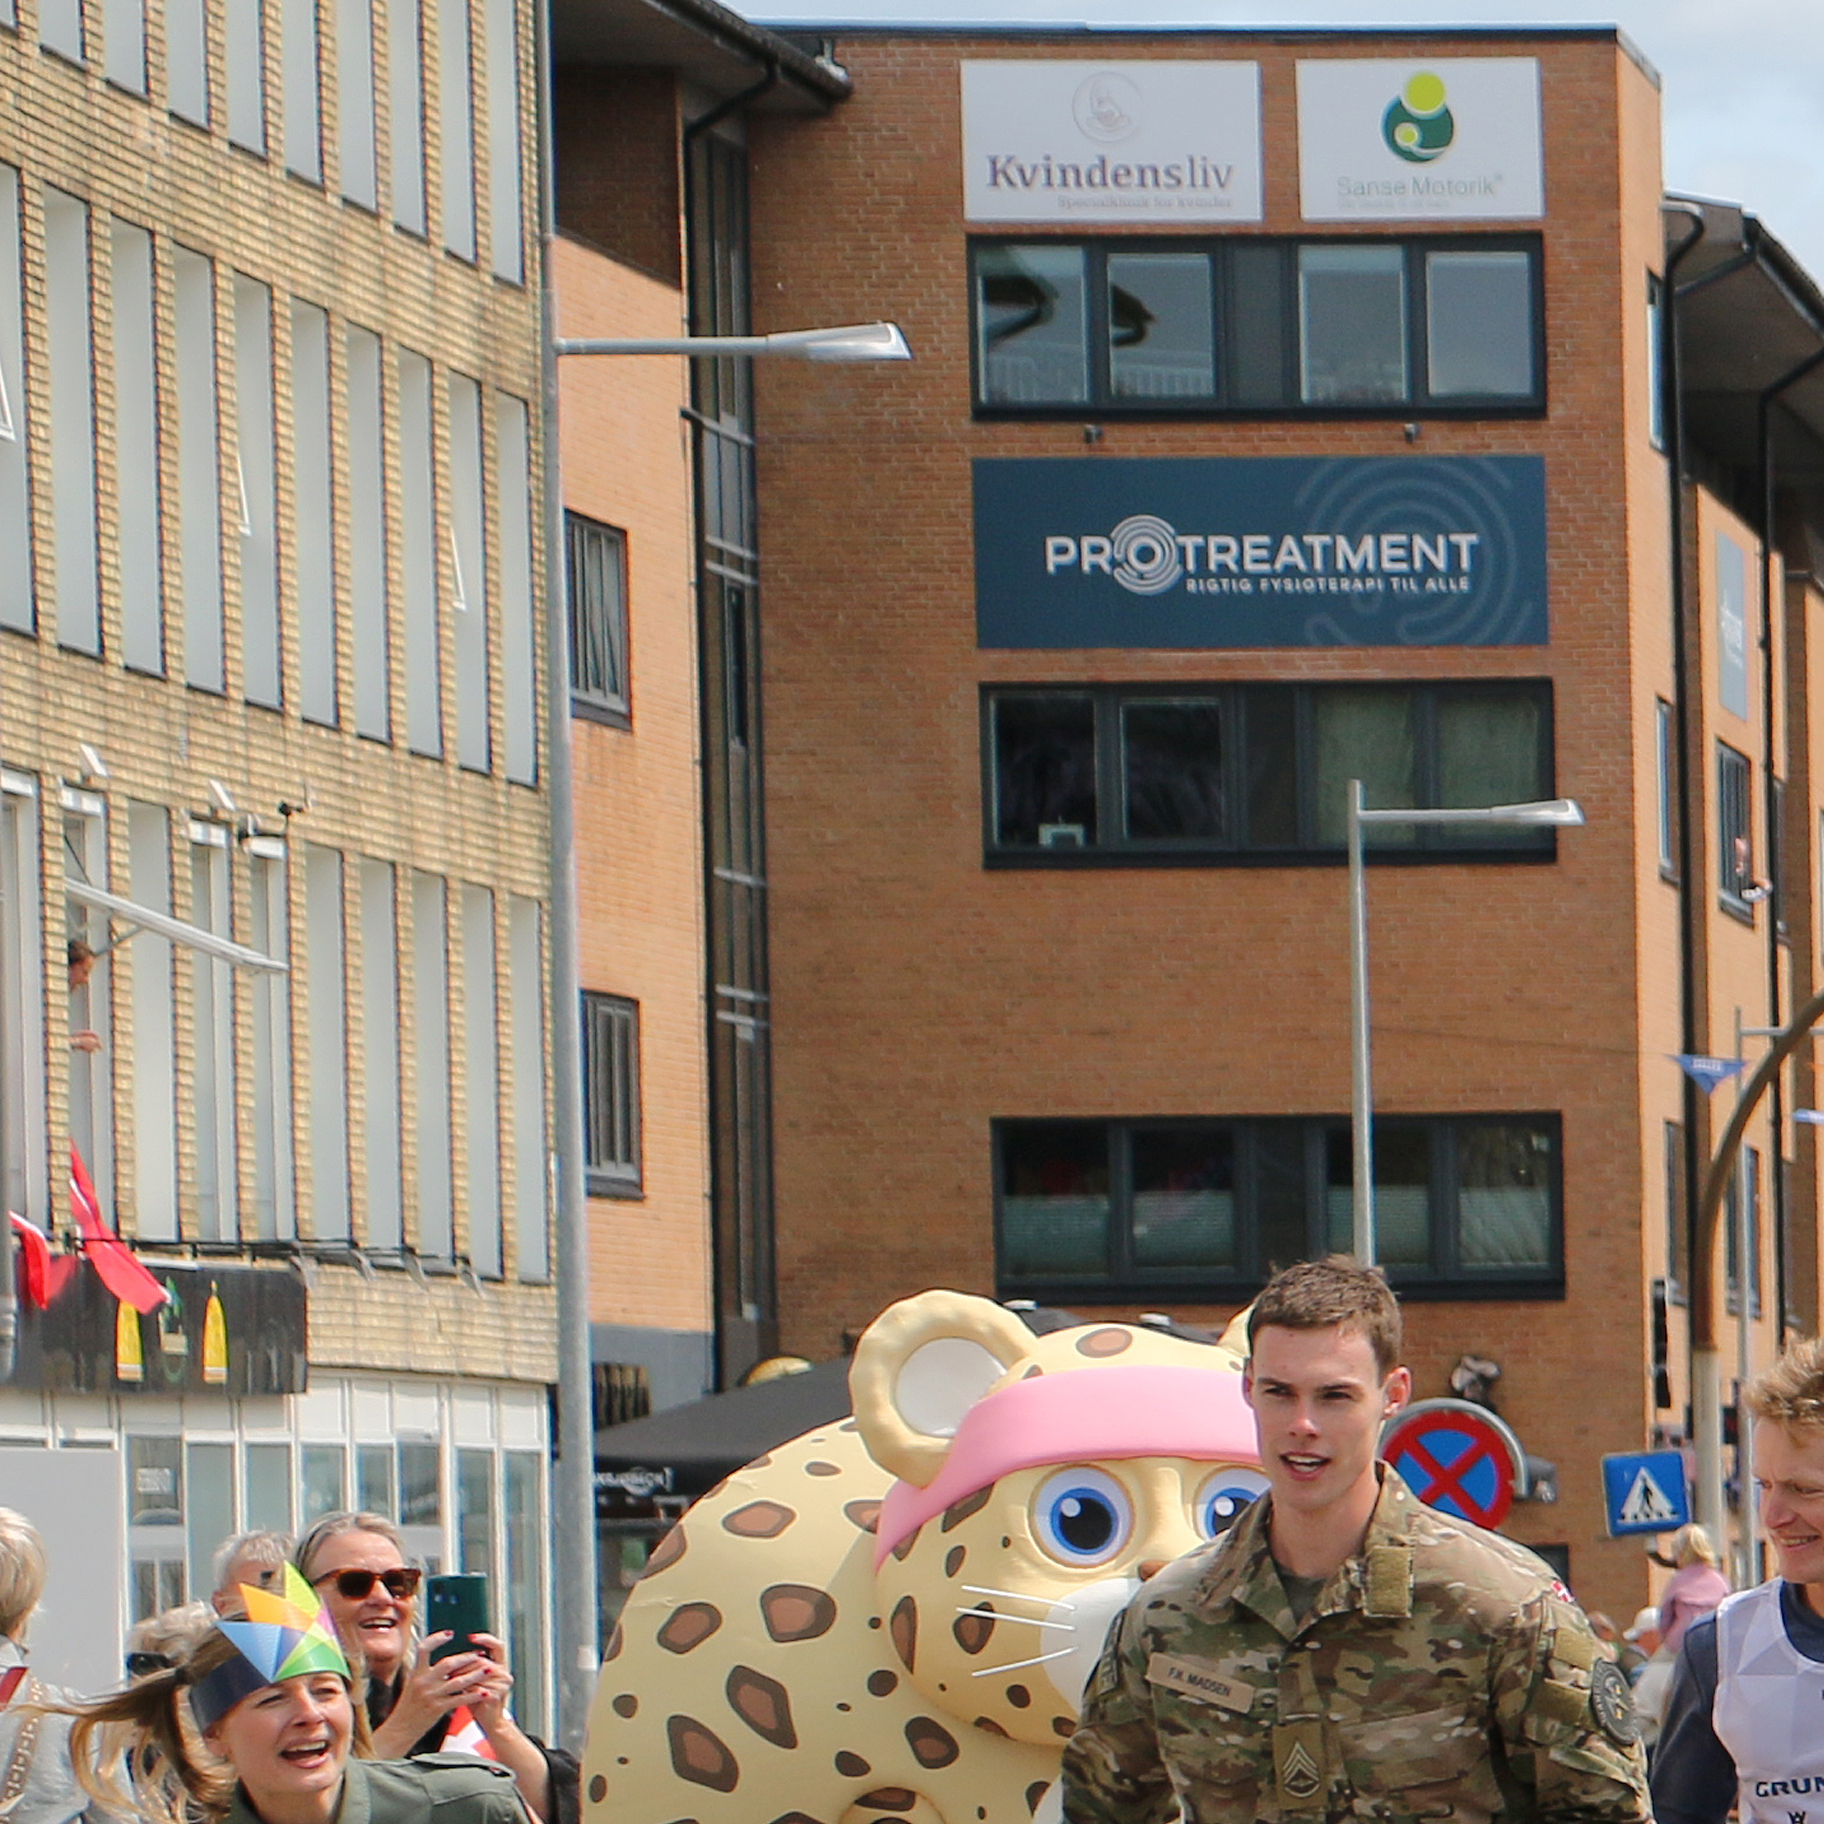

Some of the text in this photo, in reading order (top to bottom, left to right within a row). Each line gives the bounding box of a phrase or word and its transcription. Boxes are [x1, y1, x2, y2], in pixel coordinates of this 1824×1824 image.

[985, 154, 1233, 189] Kvindensliv
[1336, 175, 1406, 196] Sanse
[1045, 531, 1478, 575] PROTREATMENT
[1186, 576, 1469, 592] RIGTIG FYSIOTERAPI TIL ALLE
